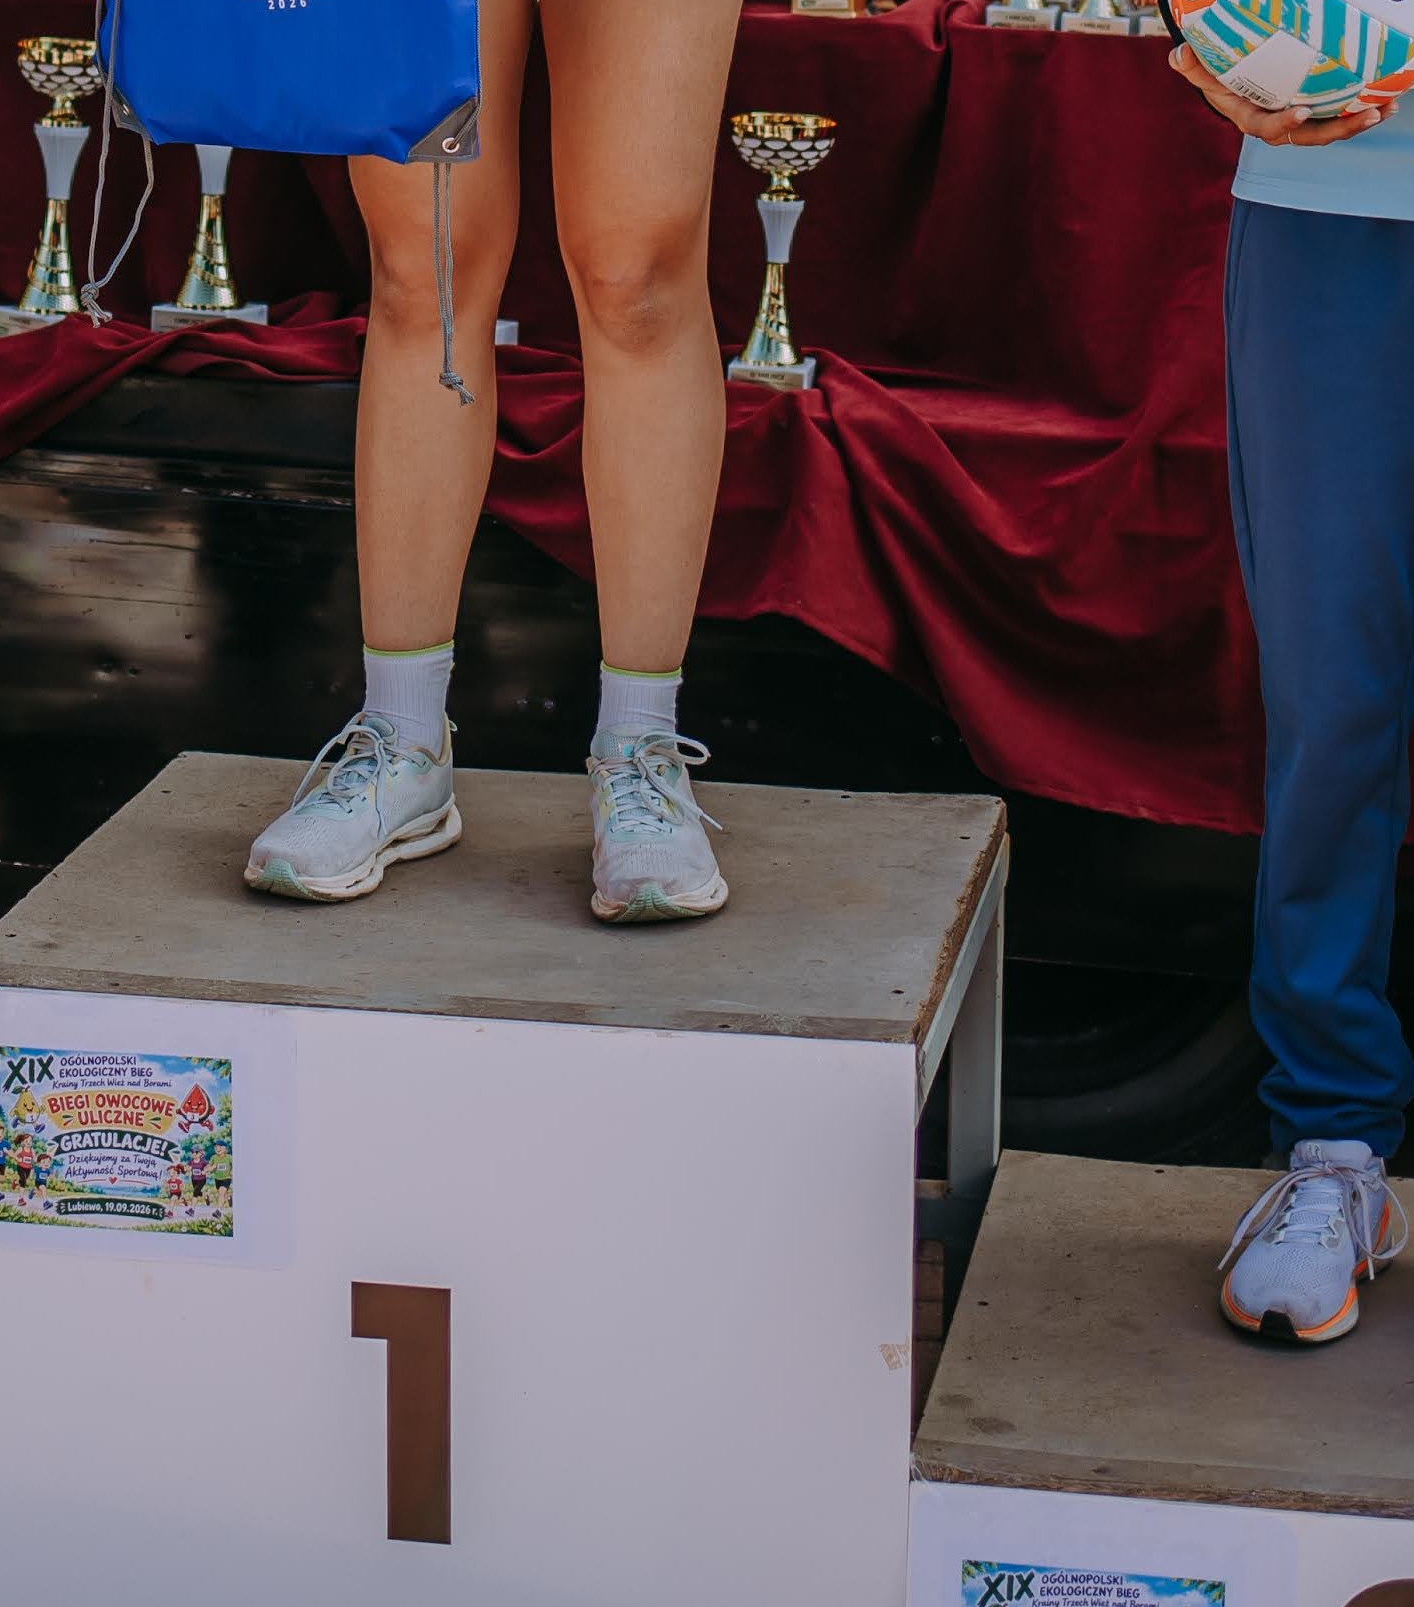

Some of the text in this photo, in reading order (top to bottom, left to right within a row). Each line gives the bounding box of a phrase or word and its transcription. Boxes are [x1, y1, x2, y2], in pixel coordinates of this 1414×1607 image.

[60, 1052, 137, 1066] OGÓLNOPOLSKI
[2, 1055, 55, 1093] XIX
[59, 1066, 153, 1078] EKOLOGICZNY BIEG
[52, 1079, 78, 1089] Krainy
[80, 1078, 105, 1087] Trzech
[126, 1078, 141, 1087] nad
[143, 1078, 172, 1088] Borami
[47, 1093, 176, 1117] BIEGI OWOCOWE
[77, 1110, 145, 1127] ULICZNE
[61, 1131, 168, 1156] GRATULACJE!
[68, 1153, 157, 1167] Dziękujemy za Twoją
[64, 1164, 163, 1180] Aktywność Sportową!
[67, 1202, 103, 1213] Lubiewo,
[104, 1202, 151, 1215] 19.09.2026
[351, 1281, 452, 1545] 1
[1041, 1570, 1123, 1585] OGÓLNOPOLSKI
[978, 1571, 1035, 1607] XIX
[1040, 1586, 1140, 1598] EKOLOGICZNY BIEG
